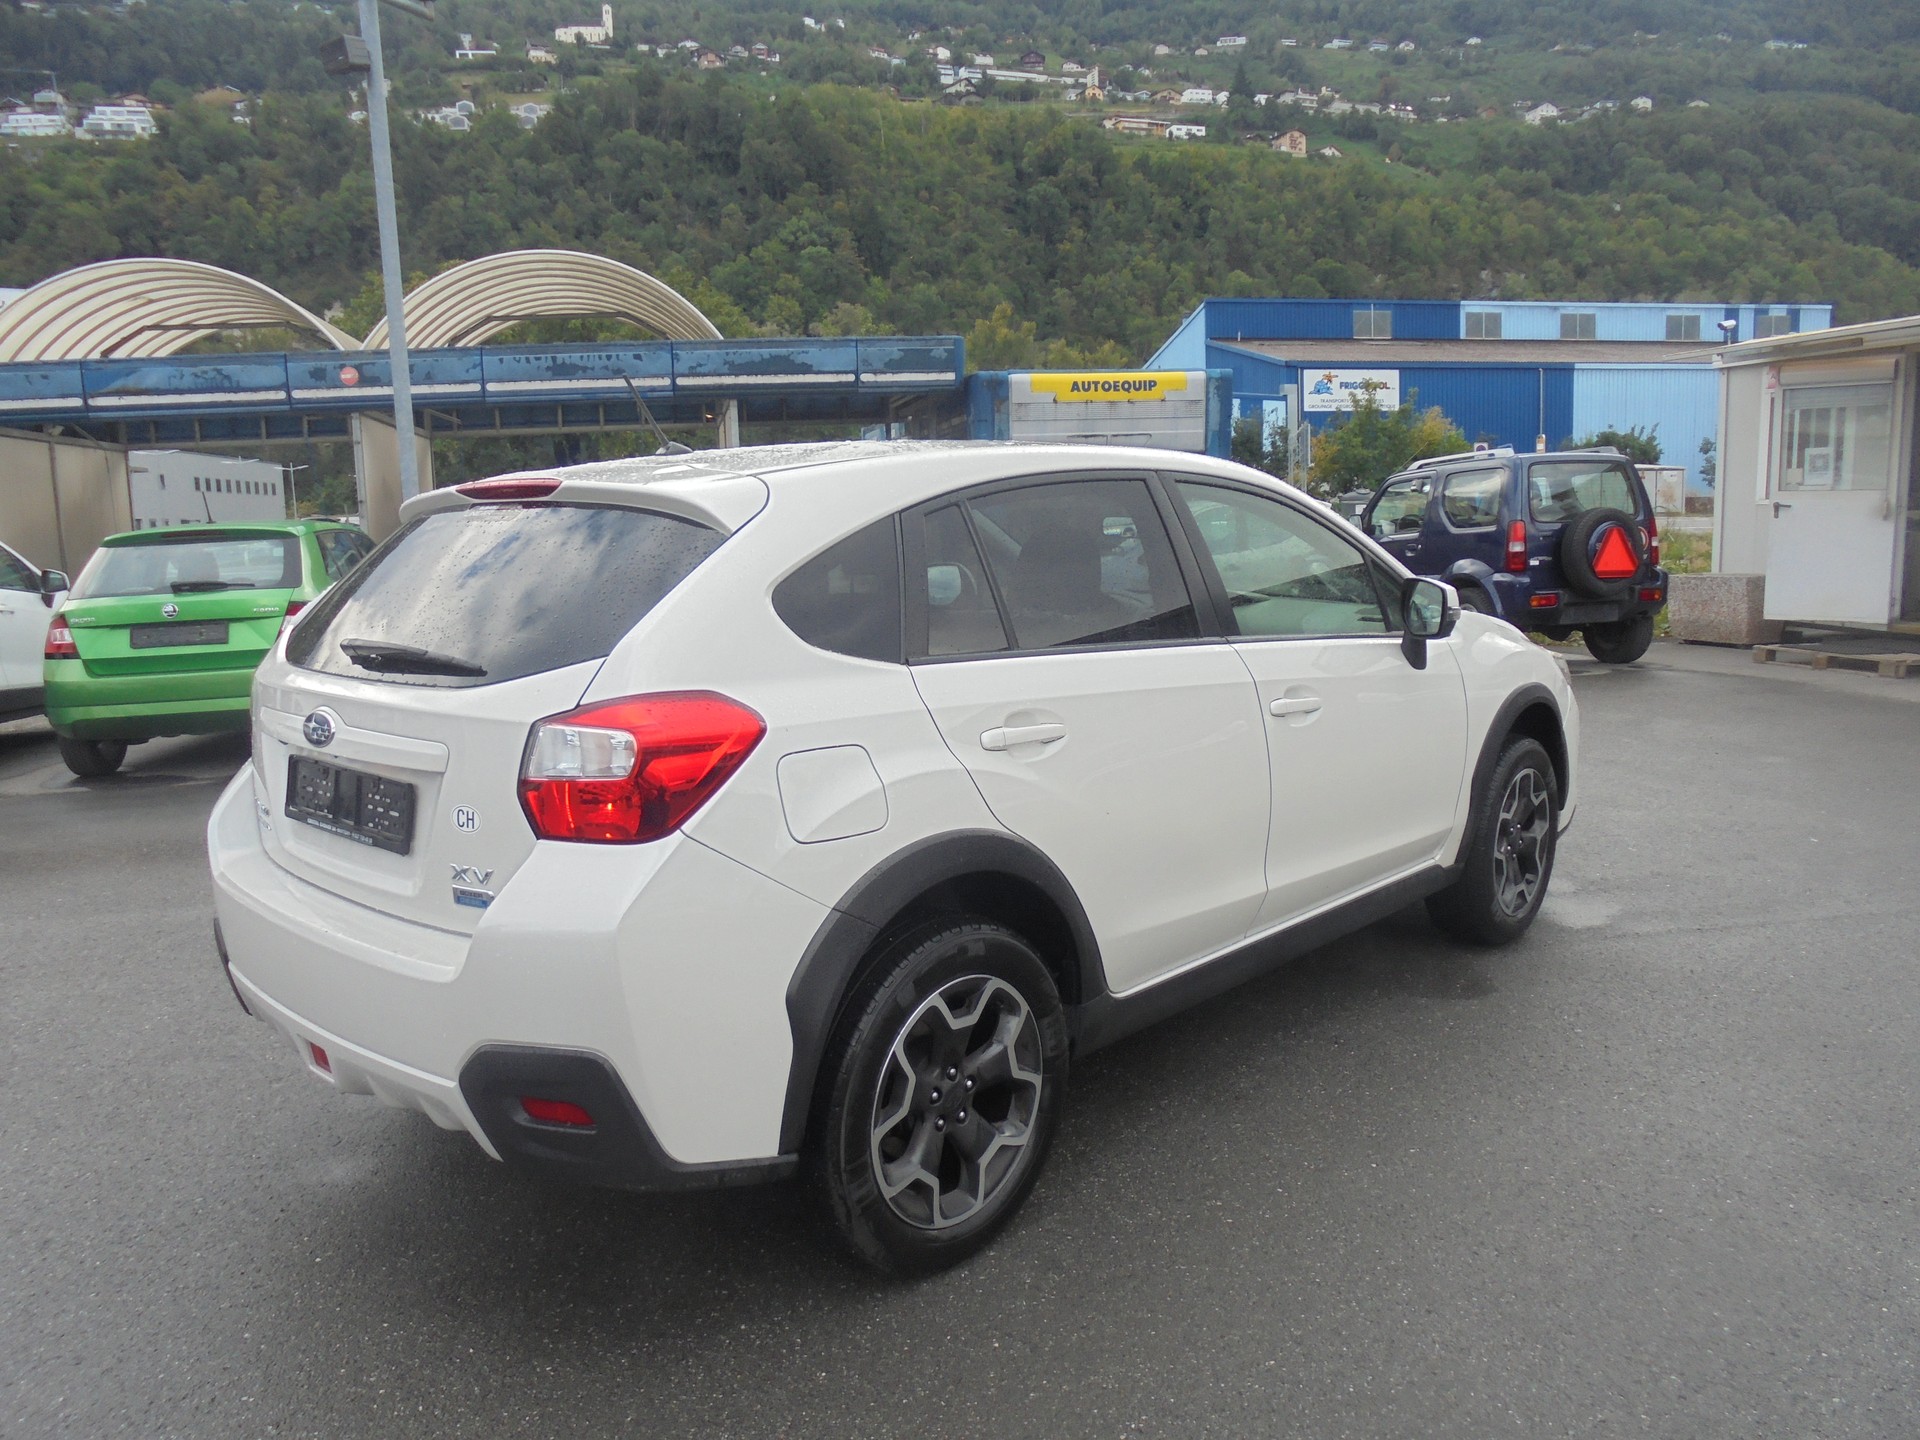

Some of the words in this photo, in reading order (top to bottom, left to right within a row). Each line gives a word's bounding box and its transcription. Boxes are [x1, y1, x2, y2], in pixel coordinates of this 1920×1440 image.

[1070, 380, 1158, 393] AUTOEQUIP
[457, 809, 475, 829] CH
[450, 863, 495, 885] XV
